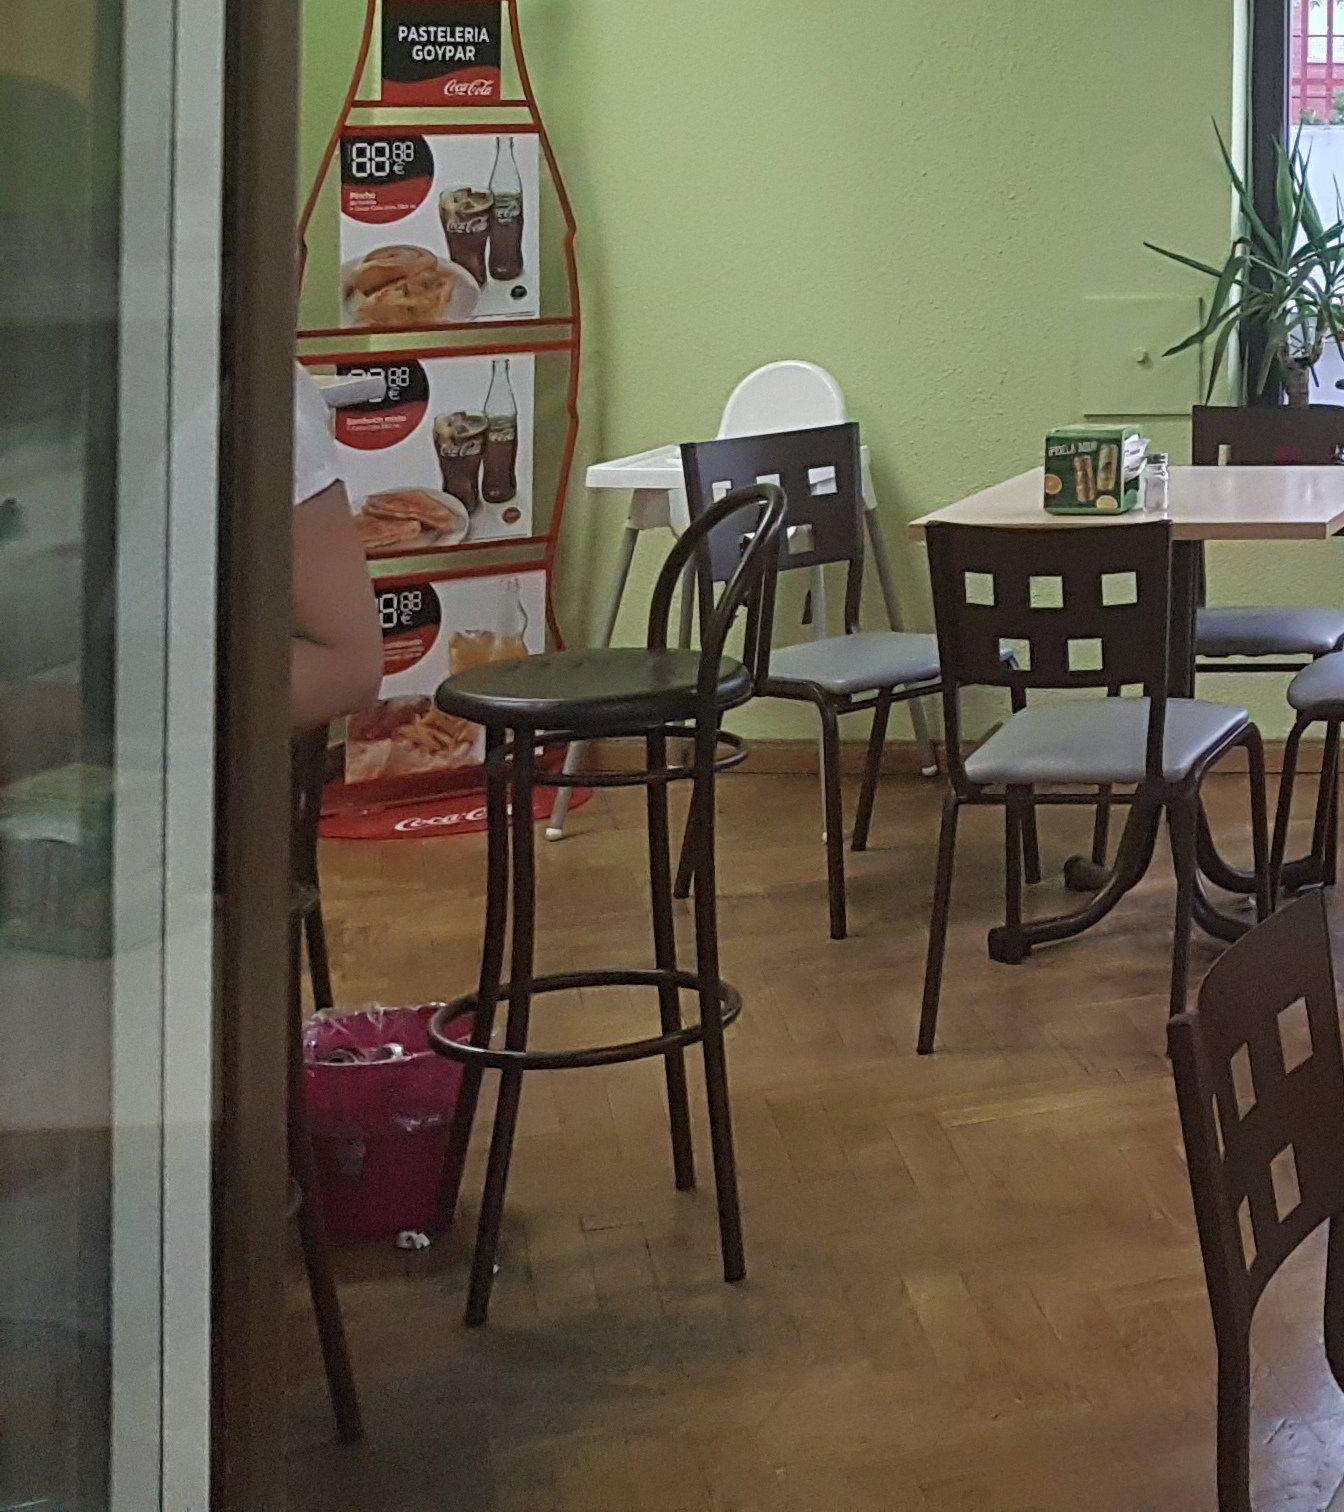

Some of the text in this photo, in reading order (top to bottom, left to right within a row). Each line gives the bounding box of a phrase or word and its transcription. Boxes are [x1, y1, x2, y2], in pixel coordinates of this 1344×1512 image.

[397, 26, 490, 43] PASTELERIA
[411, 45, 476, 61] GOYPAR
[352, 142, 390, 178] 88
